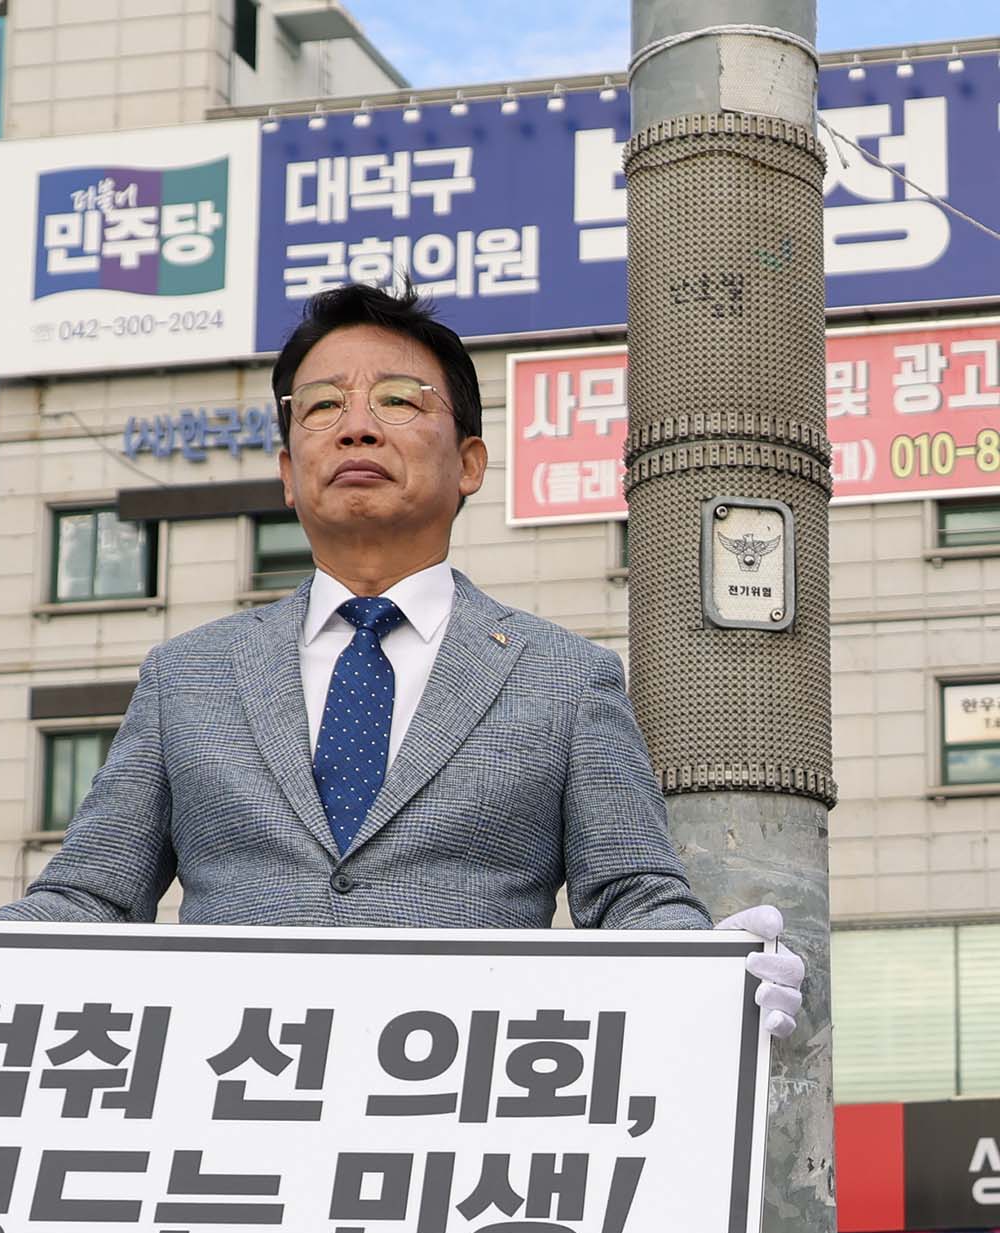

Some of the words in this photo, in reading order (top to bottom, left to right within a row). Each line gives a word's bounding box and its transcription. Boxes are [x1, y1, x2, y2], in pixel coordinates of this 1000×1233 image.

[71, 177, 139, 212] 더불어
[285, 147, 476, 225] 대덕구
[44, 201, 223, 275] 민주당
[283, 225, 540, 299] 국회의원
[58, 309, 224, 341] 042-300-2024
[728, 585, 772, 598] 전기위험
[207, 1008, 334, 1121] 선
[366, 1010, 656, 1138] 의회,
